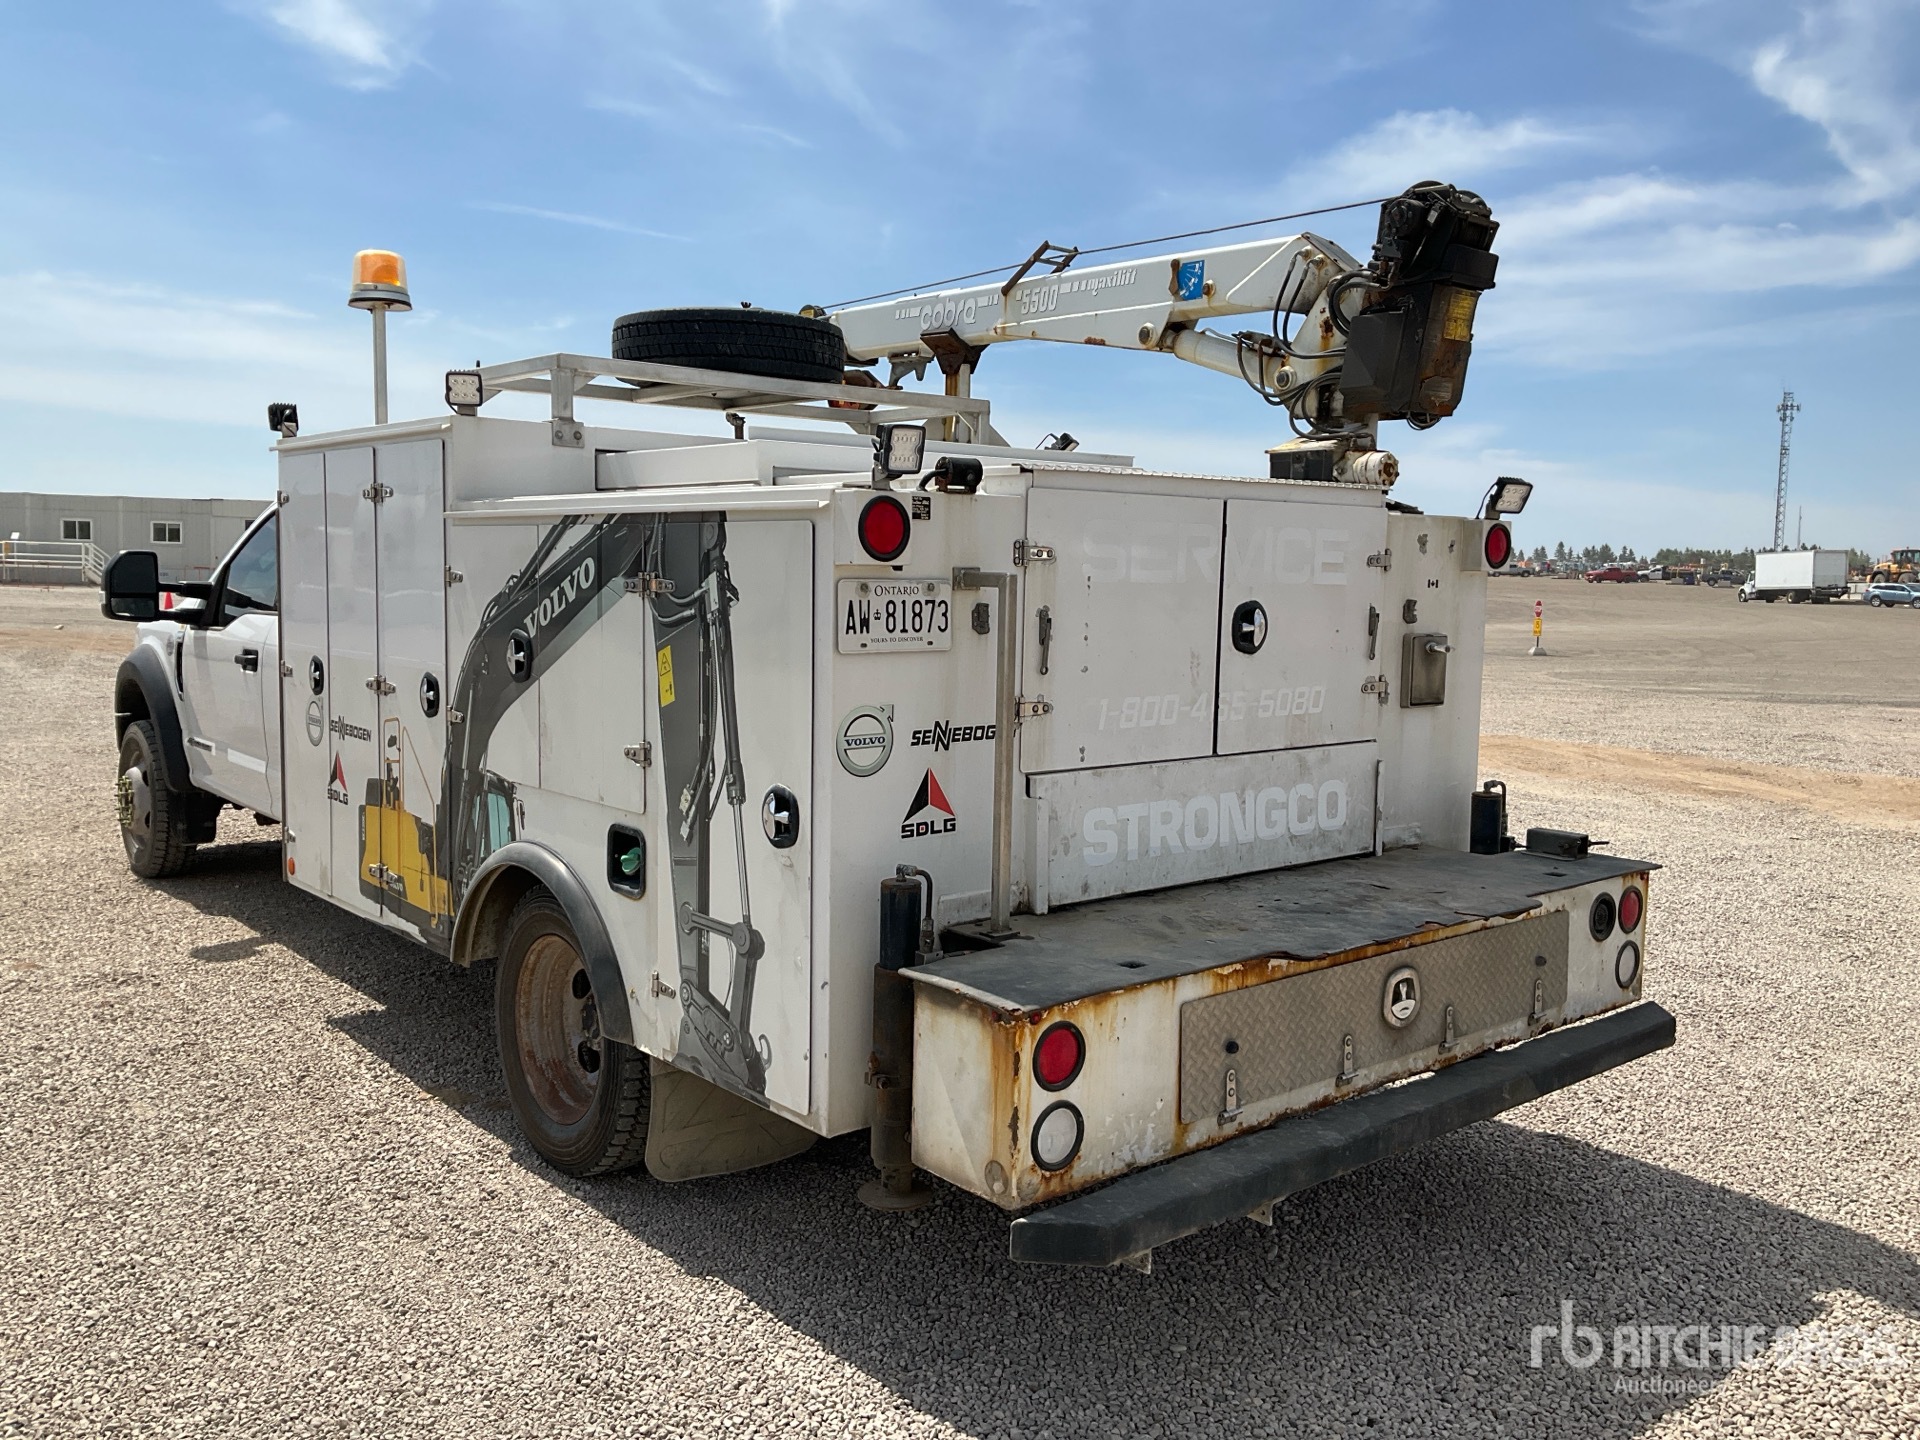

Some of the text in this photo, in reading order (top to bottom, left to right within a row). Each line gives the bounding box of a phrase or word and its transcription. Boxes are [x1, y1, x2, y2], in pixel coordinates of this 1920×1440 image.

[920, 297, 977, 330] cobra
[1020, 283, 1060, 315] 5500
[1082, 517, 1352, 586] SERVICE
[523, 557, 596, 639] VOLVO
[845, 599, 949, 635] AW 81873
[844, 735, 886, 748] VOLVO
[327, 788, 349, 806] SDLG
[901, 816, 957, 839] SDLG
[1082, 779, 1347, 867] STRONGCO
